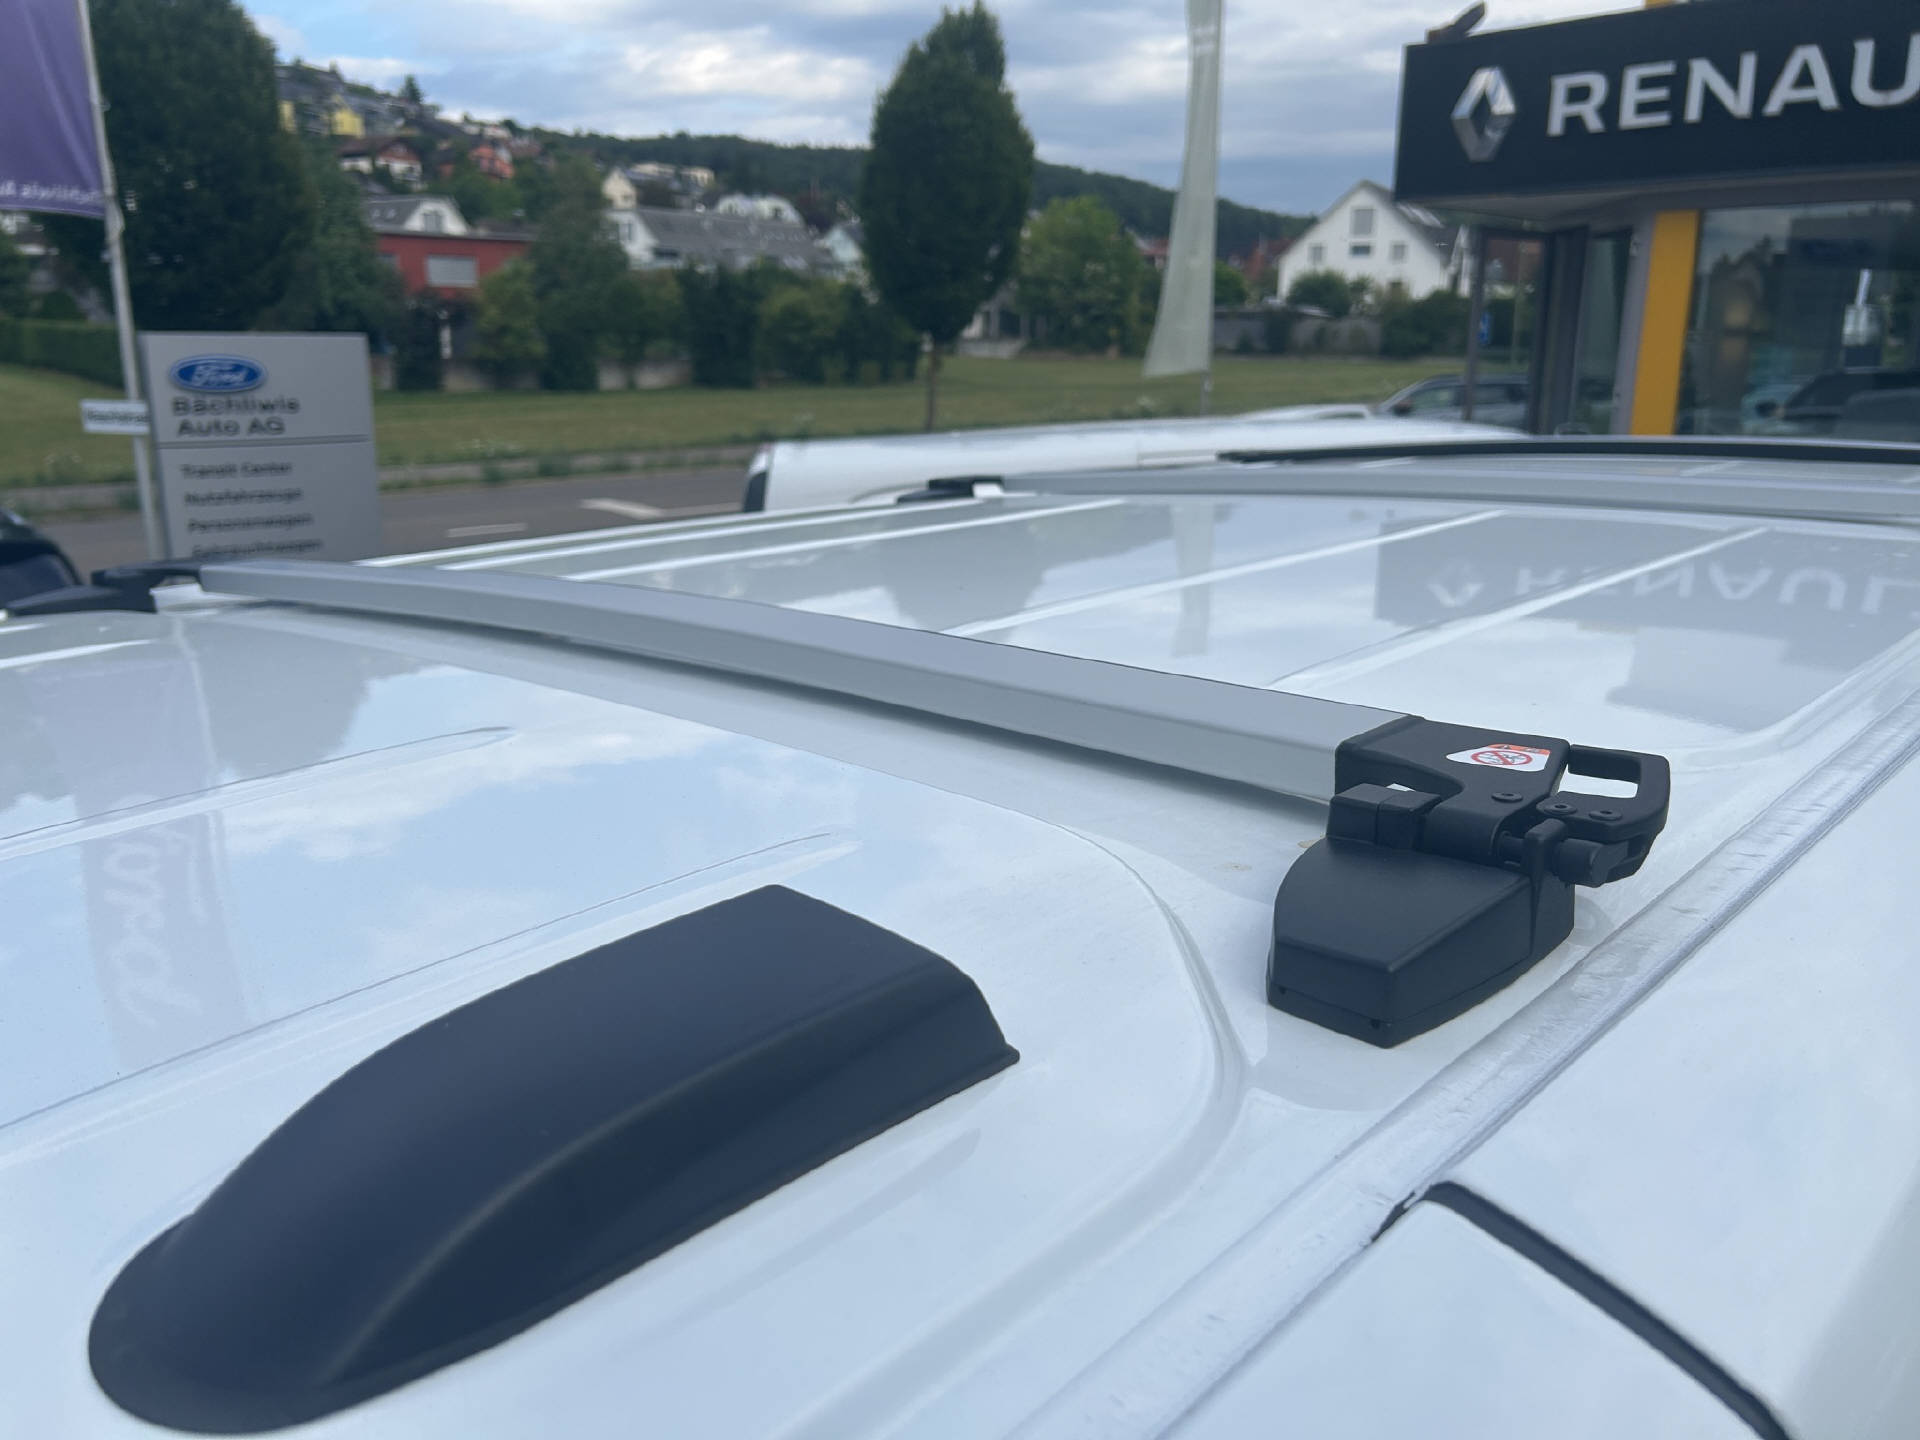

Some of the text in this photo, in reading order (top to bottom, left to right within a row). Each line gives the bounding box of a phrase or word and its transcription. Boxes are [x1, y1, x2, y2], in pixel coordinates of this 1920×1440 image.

[1546, 32, 1920, 137] RENAU
[177, 415, 286, 437] Auto AG
